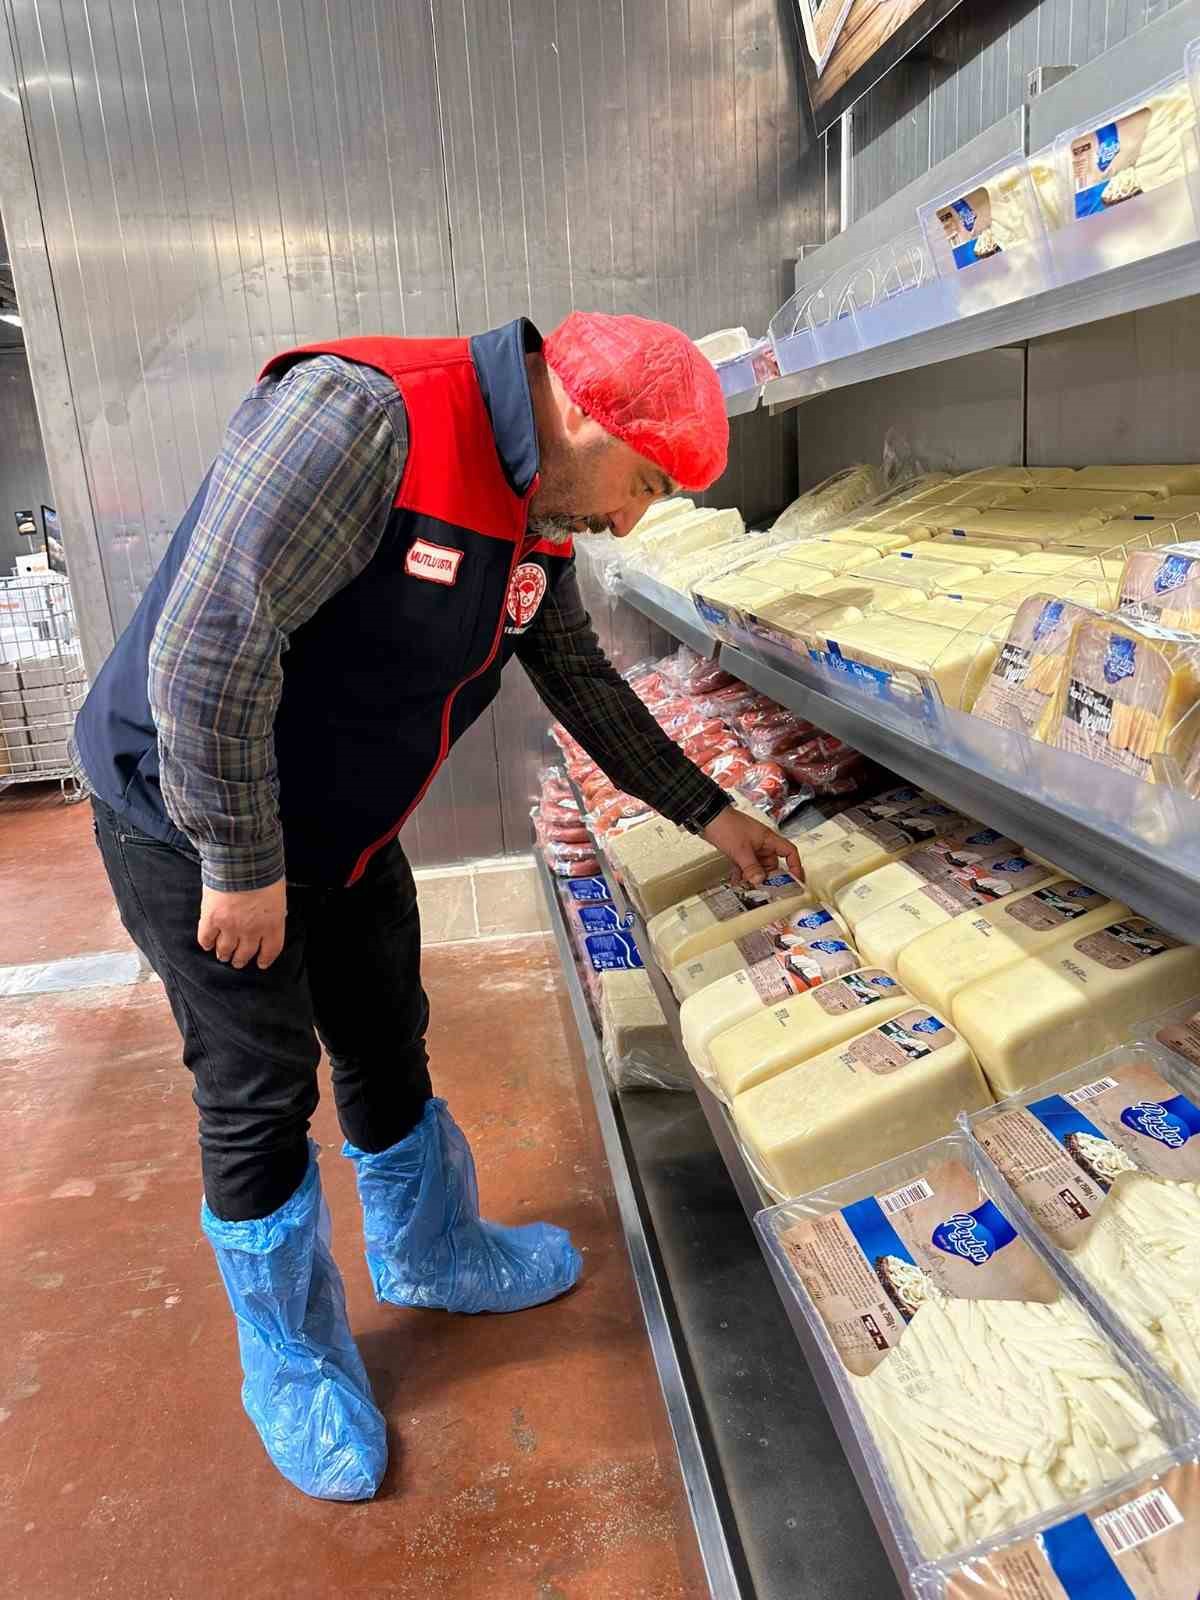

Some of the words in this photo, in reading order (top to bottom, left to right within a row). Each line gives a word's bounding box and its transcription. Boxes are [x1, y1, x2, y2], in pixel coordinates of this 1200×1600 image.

[410, 550, 437, 569] MUTLU
[1132, 1100, 1185, 1148] Peyden
[943, 1211, 990, 1264] Peyden
